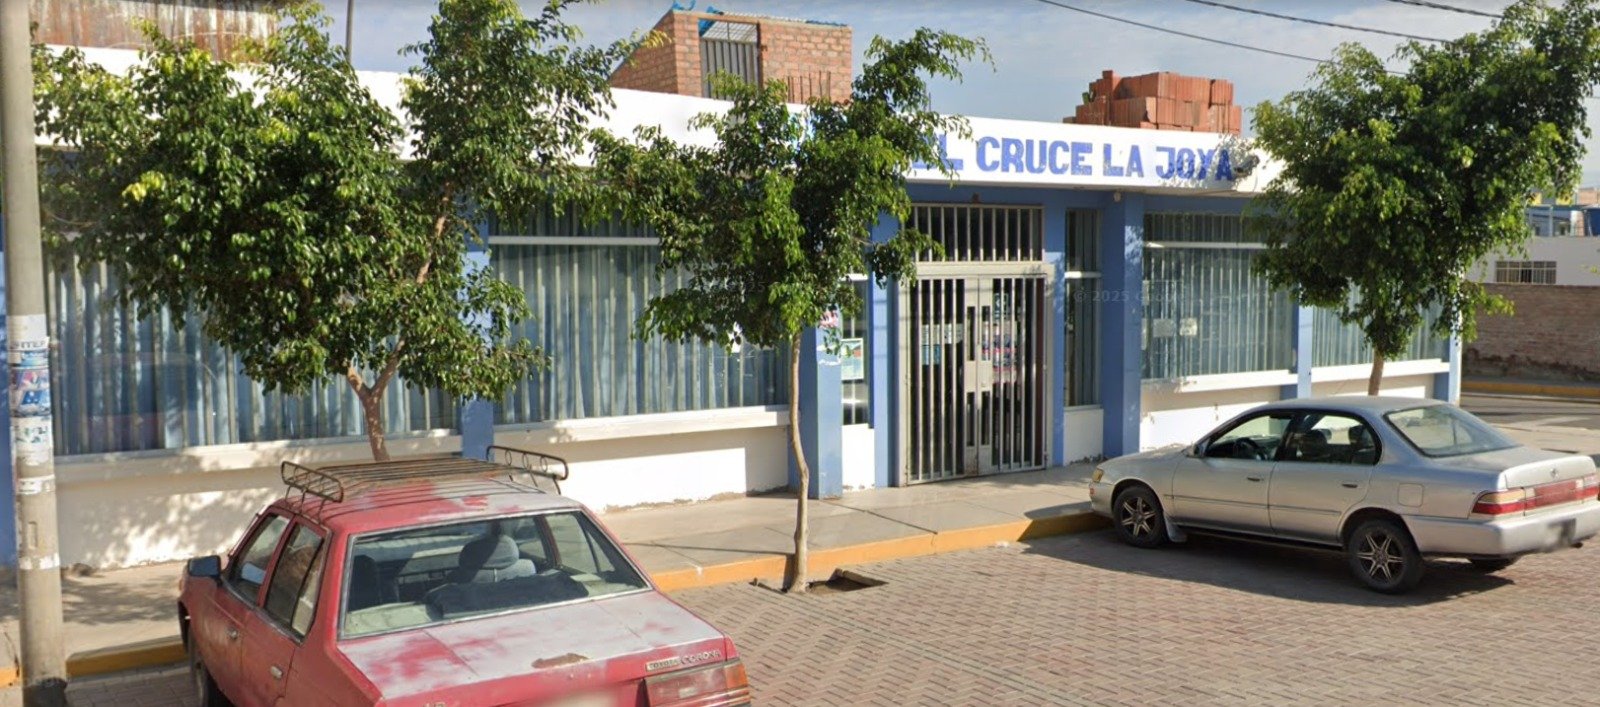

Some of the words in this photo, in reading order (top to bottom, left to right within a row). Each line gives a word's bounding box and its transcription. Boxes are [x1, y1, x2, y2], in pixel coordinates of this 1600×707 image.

[975, 135, 1093, 176] CRUCE
[1102, 143, 1146, 178] LA
[1155, 145, 1234, 182] JOYA
